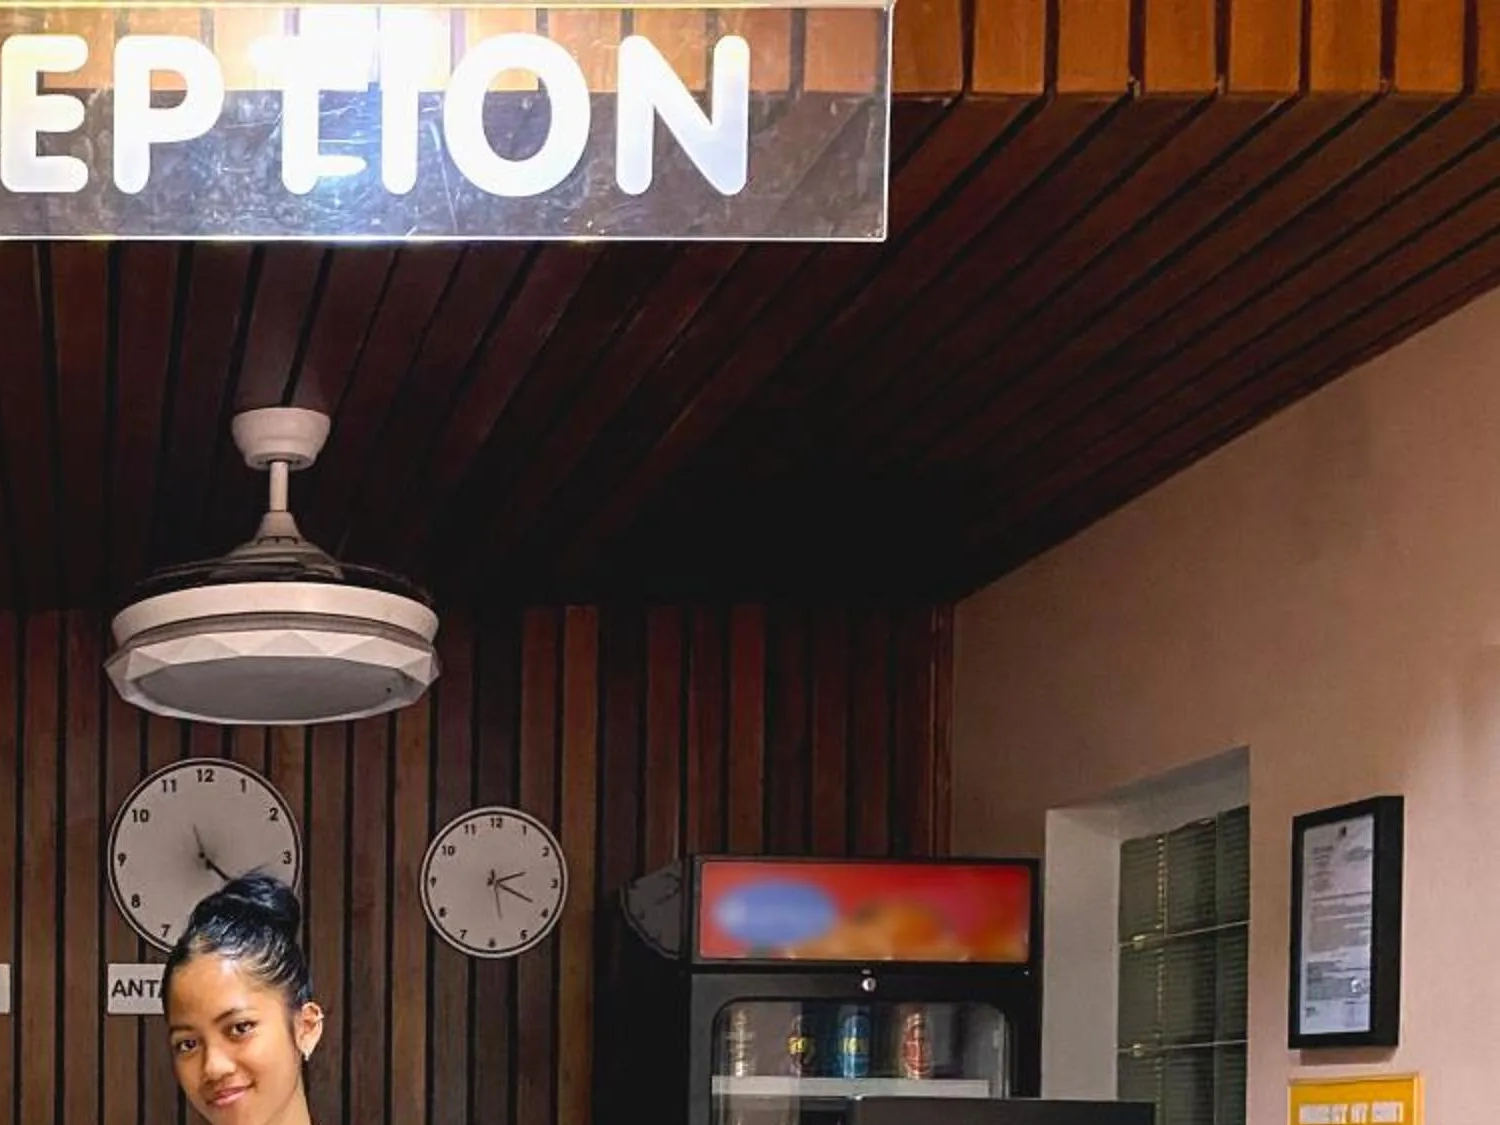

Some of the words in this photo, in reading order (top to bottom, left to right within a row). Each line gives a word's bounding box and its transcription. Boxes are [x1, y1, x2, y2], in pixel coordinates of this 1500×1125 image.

[196, 769, 214, 783] 12
[162, 780, 176, 793] 11
[132, 809, 149, 823] 10
[269, 807, 279, 821] 2
[464, 824, 476, 835] 11
[442, 845, 456, 856] 10
[118, 852, 126, 866] 9
[283, 851, 292, 865] 3
[131, 894, 140, 908] 8
[161, 924, 171, 938] 7
[460, 929, 468, 940] 7
[111, 978, 164, 998] ANT
